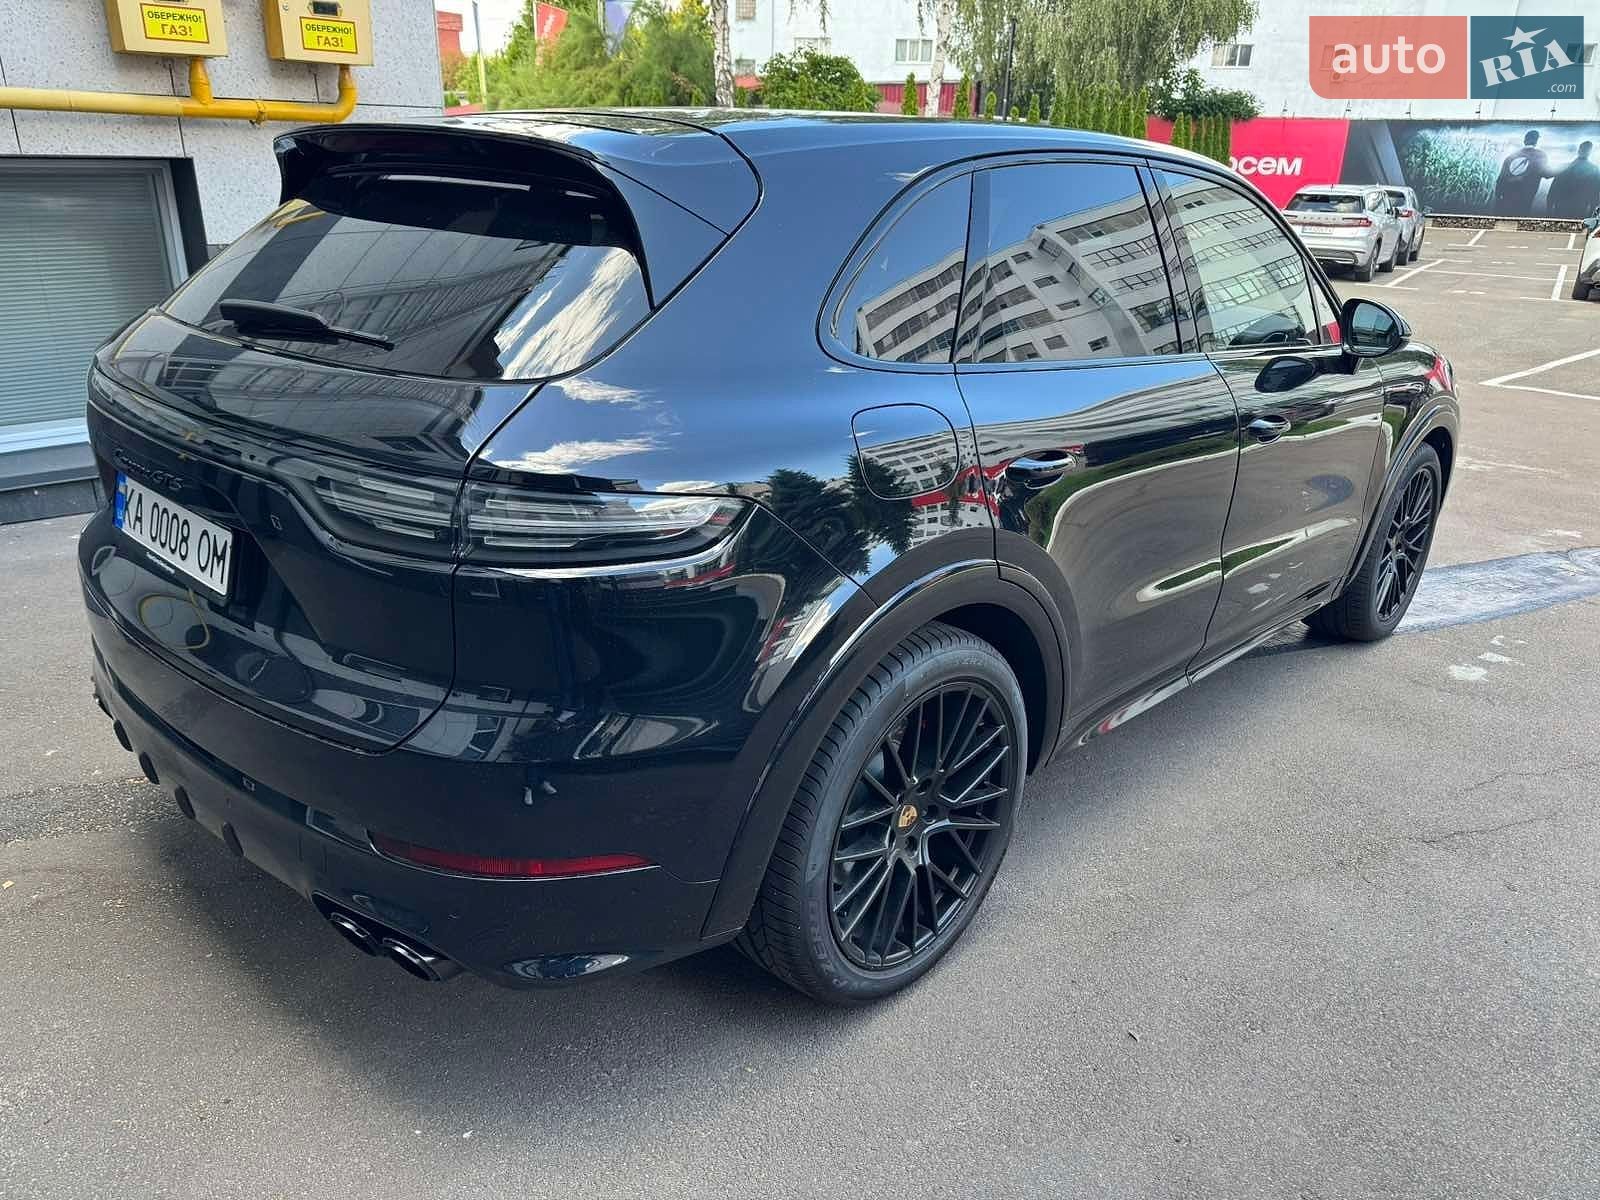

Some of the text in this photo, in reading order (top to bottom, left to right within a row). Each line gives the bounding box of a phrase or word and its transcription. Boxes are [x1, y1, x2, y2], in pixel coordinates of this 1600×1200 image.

[147, 11, 202, 23] ОБЕРЕЖНО!
[161, 24, 193, 36] ГАЗ!
[305, 24, 353, 35] ОБЕРЕЖНО!
[316, 35, 344, 47] ГАЗ!
[123, 485, 228, 585] KA 0008 OM
